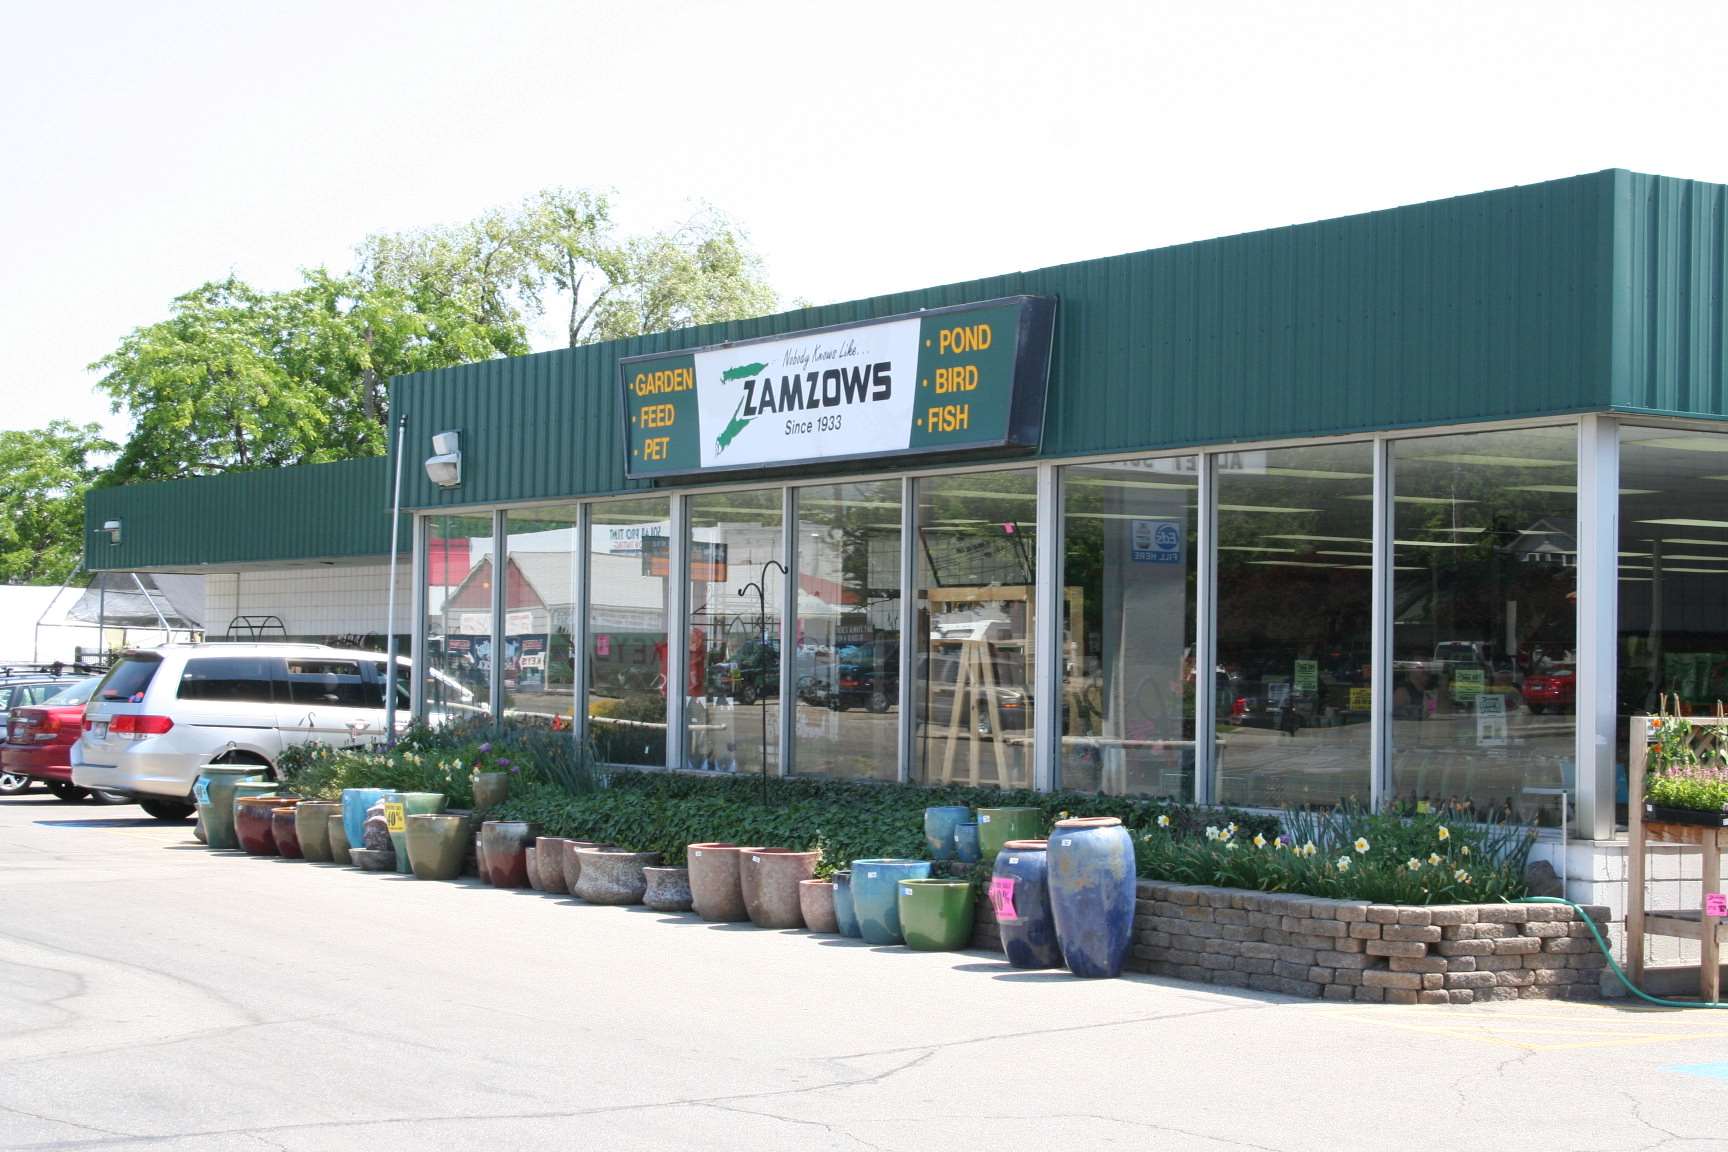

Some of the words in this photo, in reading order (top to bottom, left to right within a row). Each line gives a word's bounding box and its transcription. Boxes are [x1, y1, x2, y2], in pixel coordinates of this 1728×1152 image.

[939, 323, 992, 355] POND
[783, 349, 811, 370] Nobody
[811, 344, 837, 363] Knows
[635, 367, 694, 397] GARDEN
[743, 361, 892, 417] ZAMZOWS
[935, 365, 979, 394] BIRD
[640, 403, 675, 429] FEED
[785, 419, 813, 436] Since
[817, 414, 843, 432] 1933
[928, 403, 970, 433] FISH
[643, 436, 671, 461] PET
